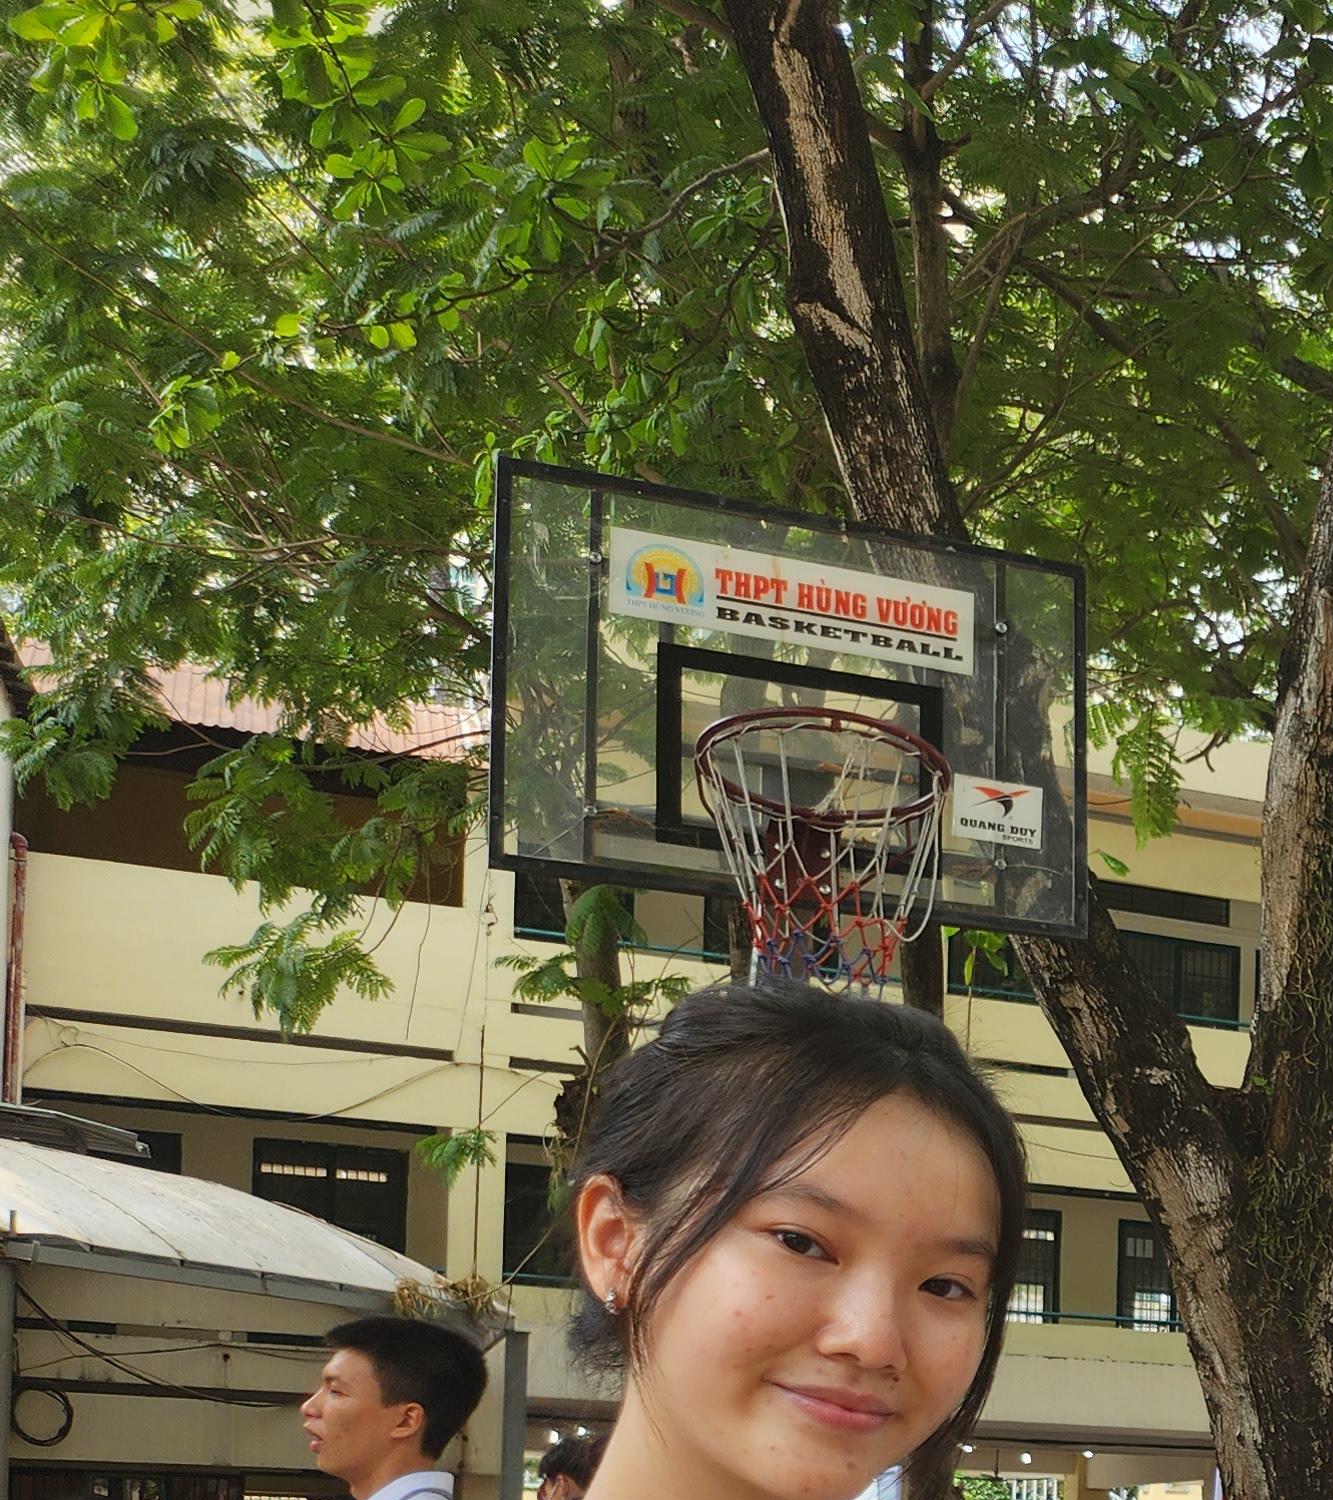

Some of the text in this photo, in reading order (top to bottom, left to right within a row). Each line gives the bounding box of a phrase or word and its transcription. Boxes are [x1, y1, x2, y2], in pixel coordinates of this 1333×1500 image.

[715, 568, 958, 636] THPT HÙNG VƯƠNG
[716, 605, 963, 661] BASKETBALL
[960, 817, 1036, 838] QUANG DUY
